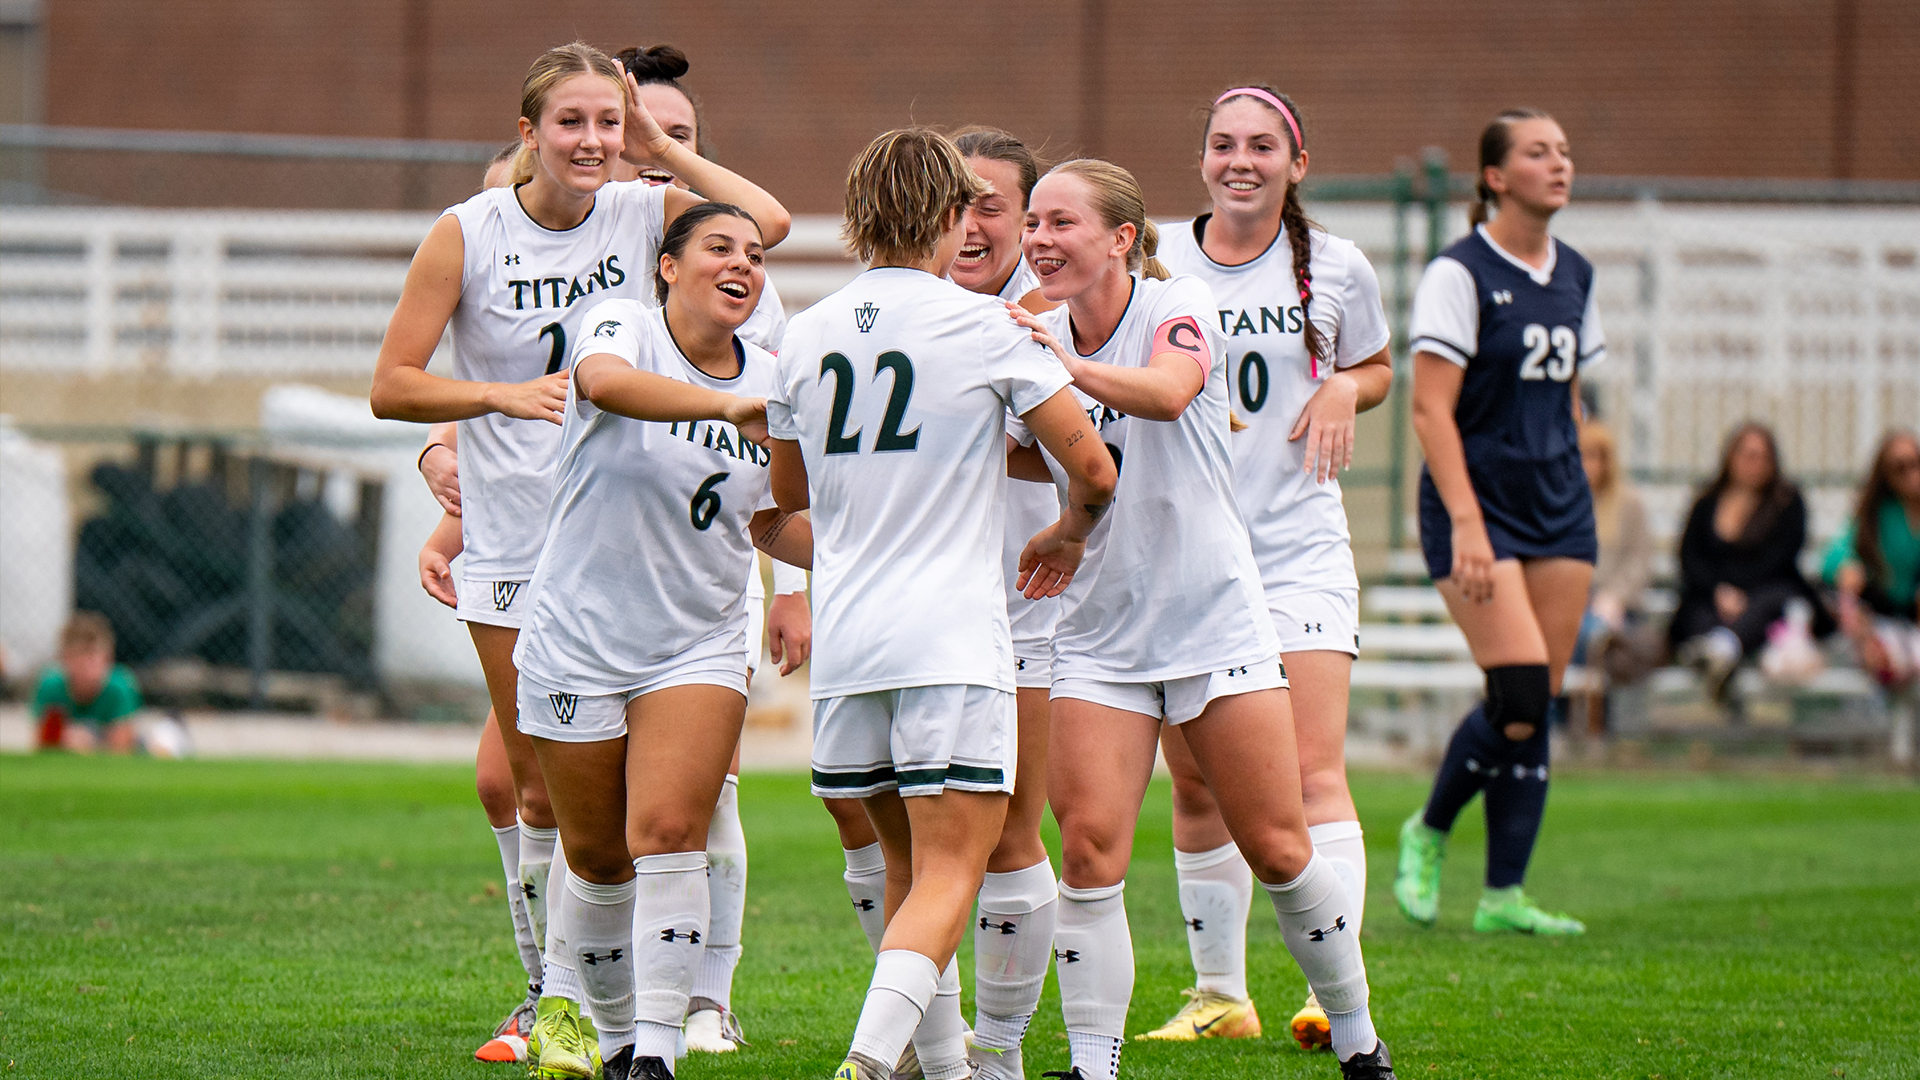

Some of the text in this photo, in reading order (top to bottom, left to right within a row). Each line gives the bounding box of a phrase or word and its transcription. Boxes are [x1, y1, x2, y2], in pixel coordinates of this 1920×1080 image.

[508, 255, 625, 310] TITANS
[1168, 323, 1201, 352] C
[1218, 306, 1303, 337] TANS
[1225, 350, 1269, 413] 0
[1519, 323, 1577, 383] 23
[818, 349, 923, 457] 22
[1065, 429, 1085, 448] 222
[690, 472, 731, 531] 6
